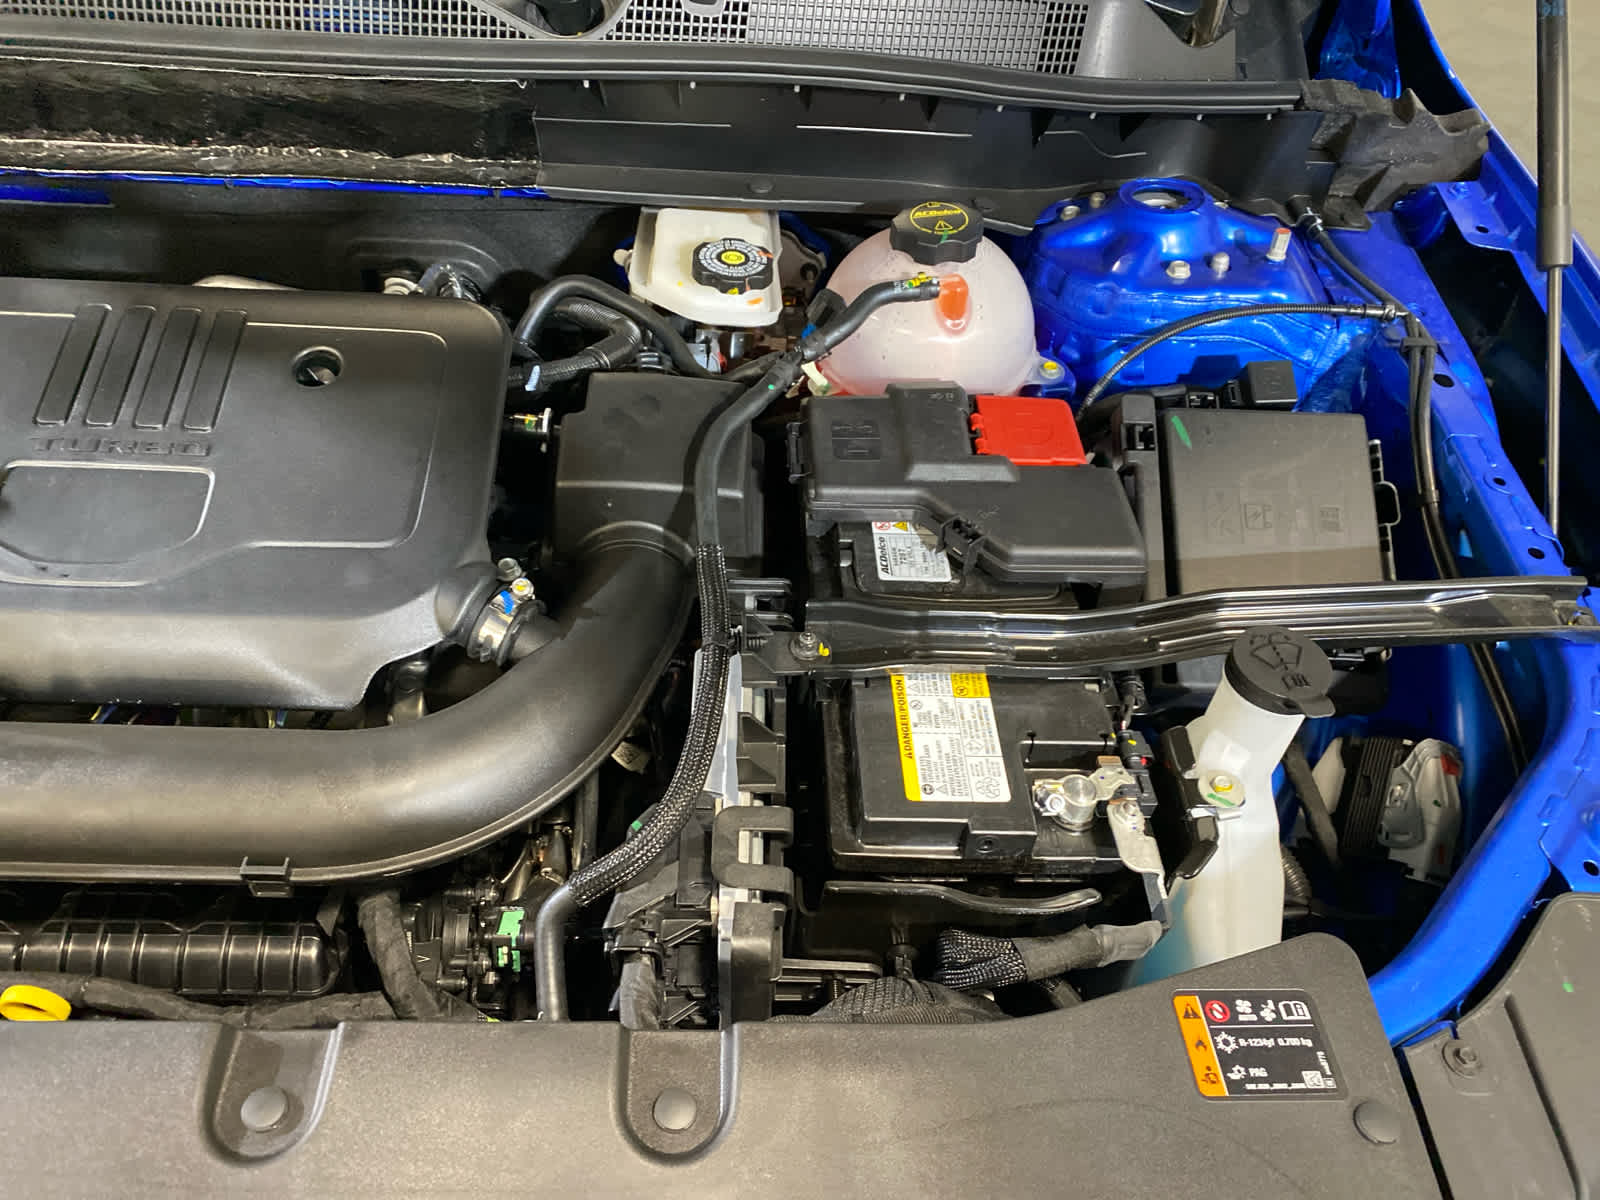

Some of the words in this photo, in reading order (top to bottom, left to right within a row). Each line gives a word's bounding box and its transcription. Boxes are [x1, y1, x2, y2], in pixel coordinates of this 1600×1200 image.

[29, 437, 212, 457] TURBO
[878, 536, 890, 575] ACDelco
[895, 679, 913, 753] DANGER/POISON
